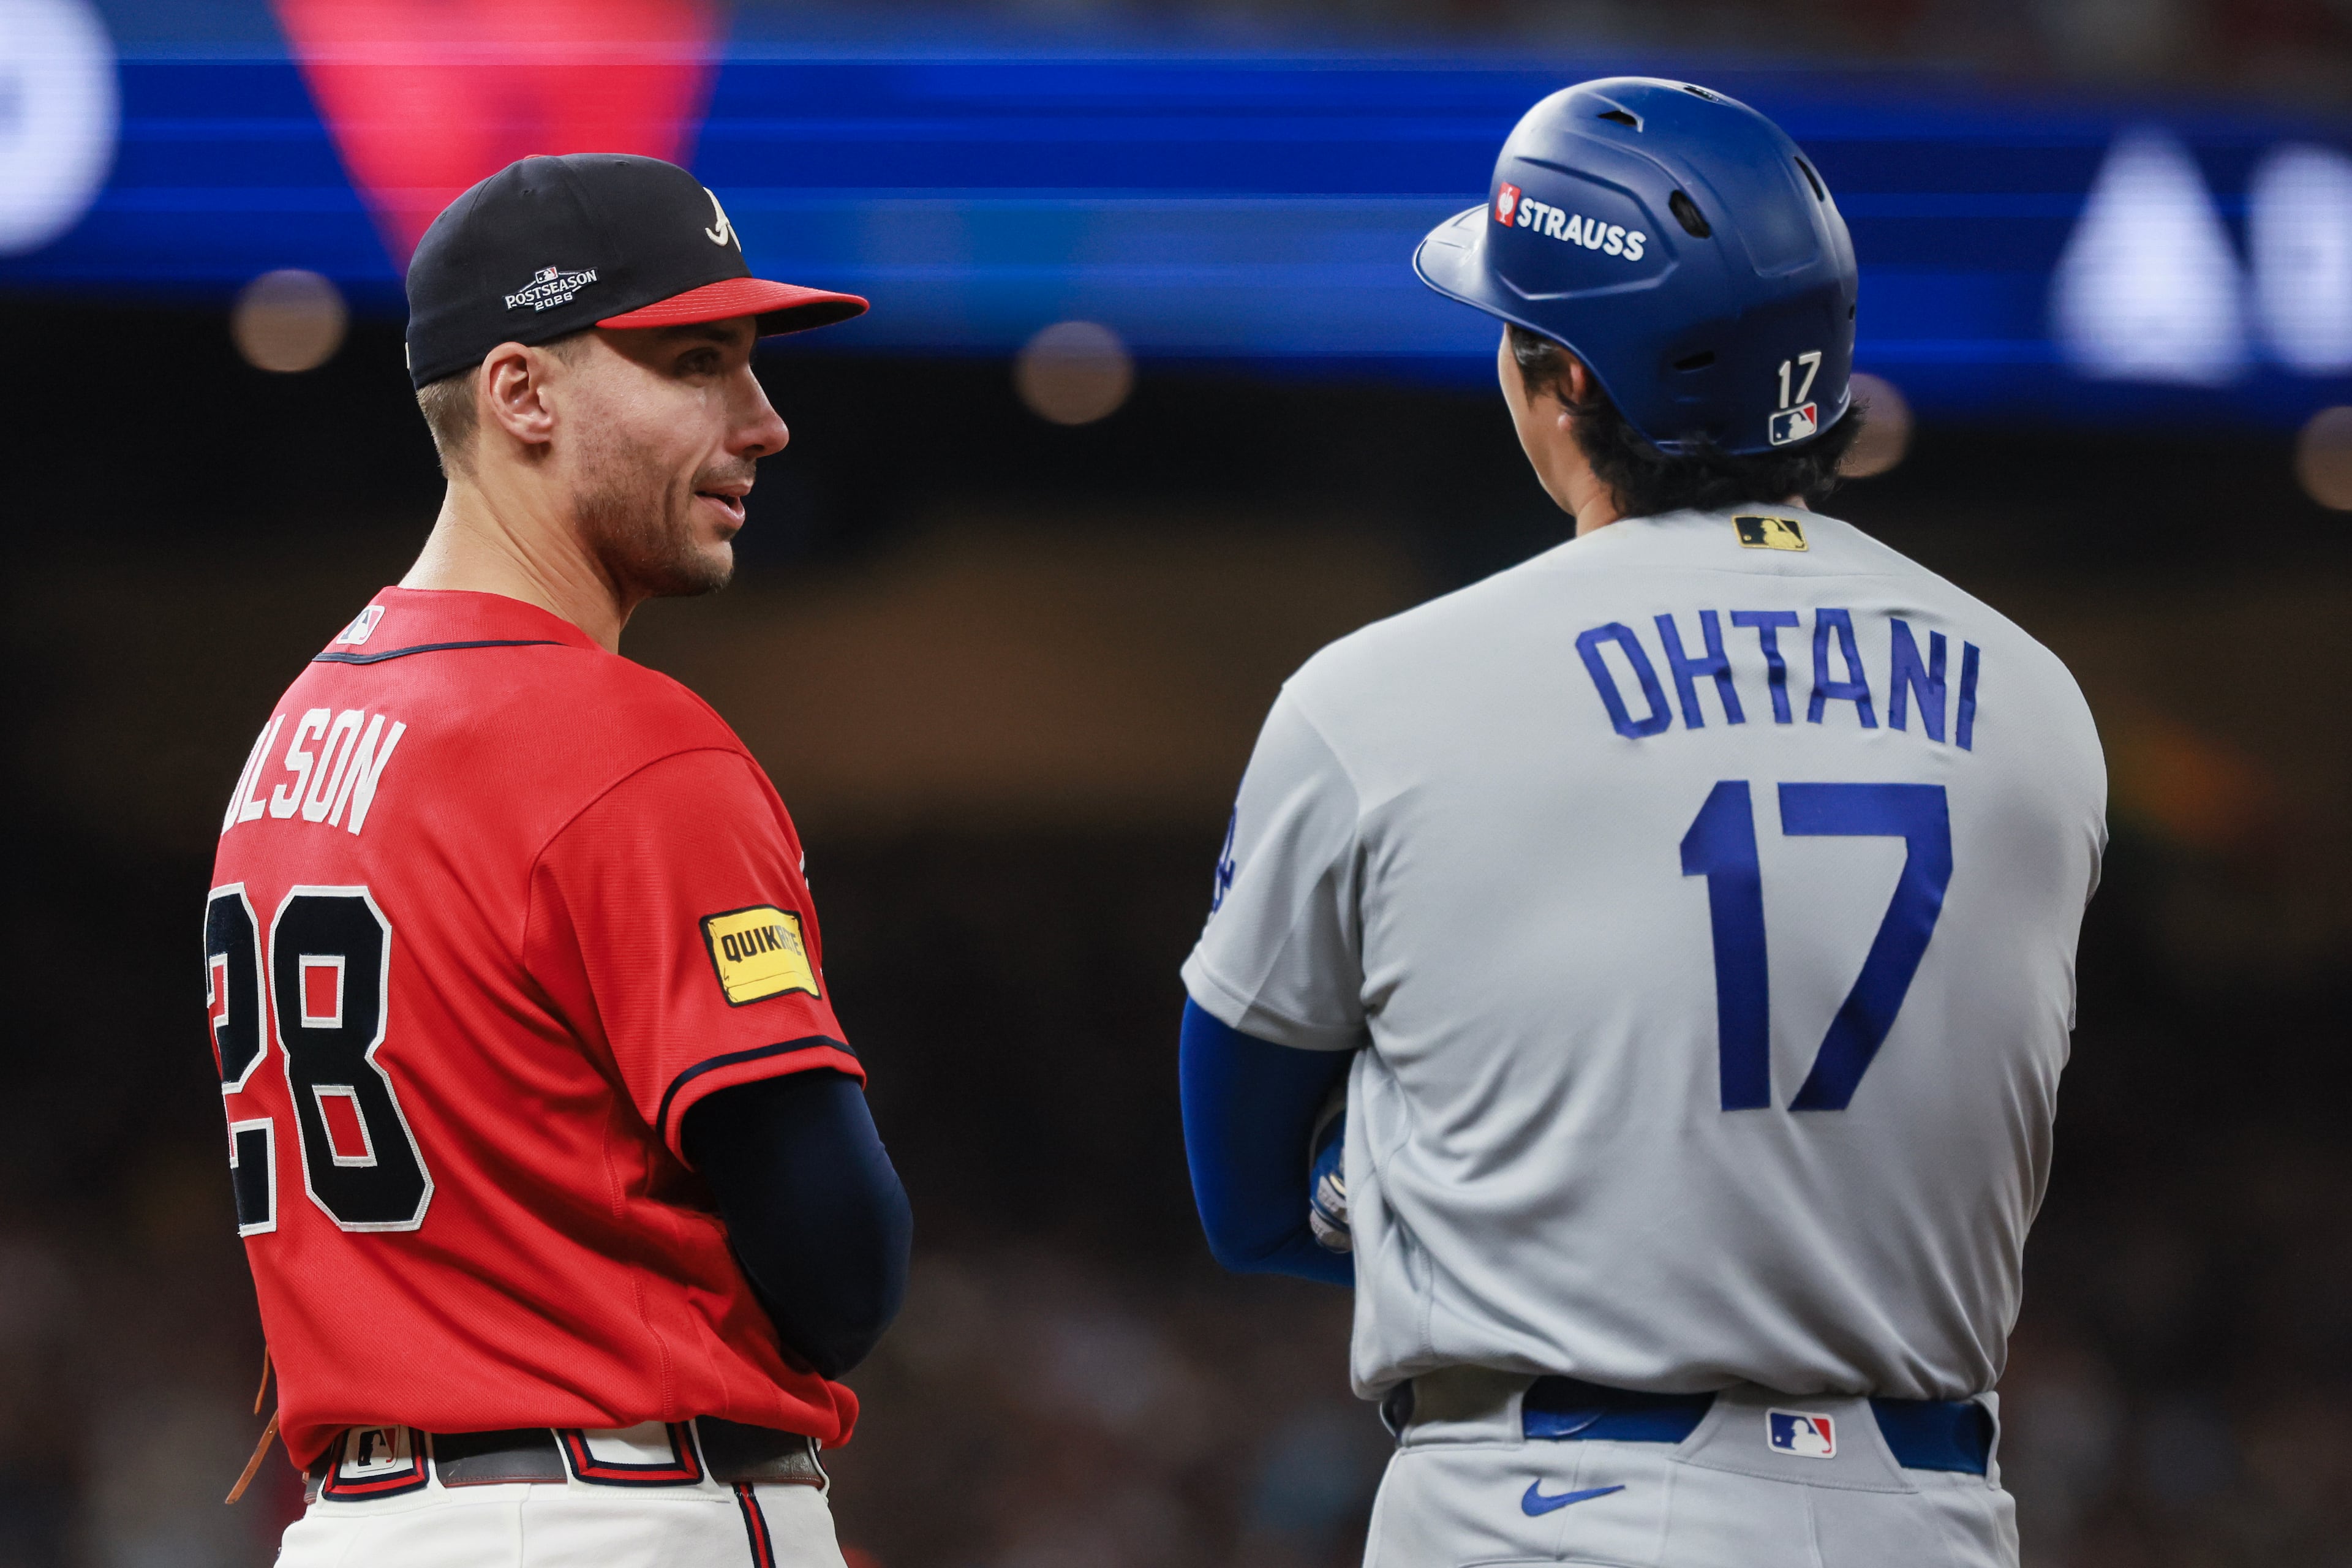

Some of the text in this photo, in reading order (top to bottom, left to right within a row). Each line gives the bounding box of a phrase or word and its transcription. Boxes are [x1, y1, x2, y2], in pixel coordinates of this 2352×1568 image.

[1516, 198, 1646, 262] STRAUSS
[505, 269, 597, 309] POSTSEASON
[534, 292, 573, 311] 2026
[1779, 351, 1822, 409] 17
[1575, 608, 1980, 752] OHTANI
[1679, 780, 1953, 1112] 17
[204, 882, 435, 1238] 28
